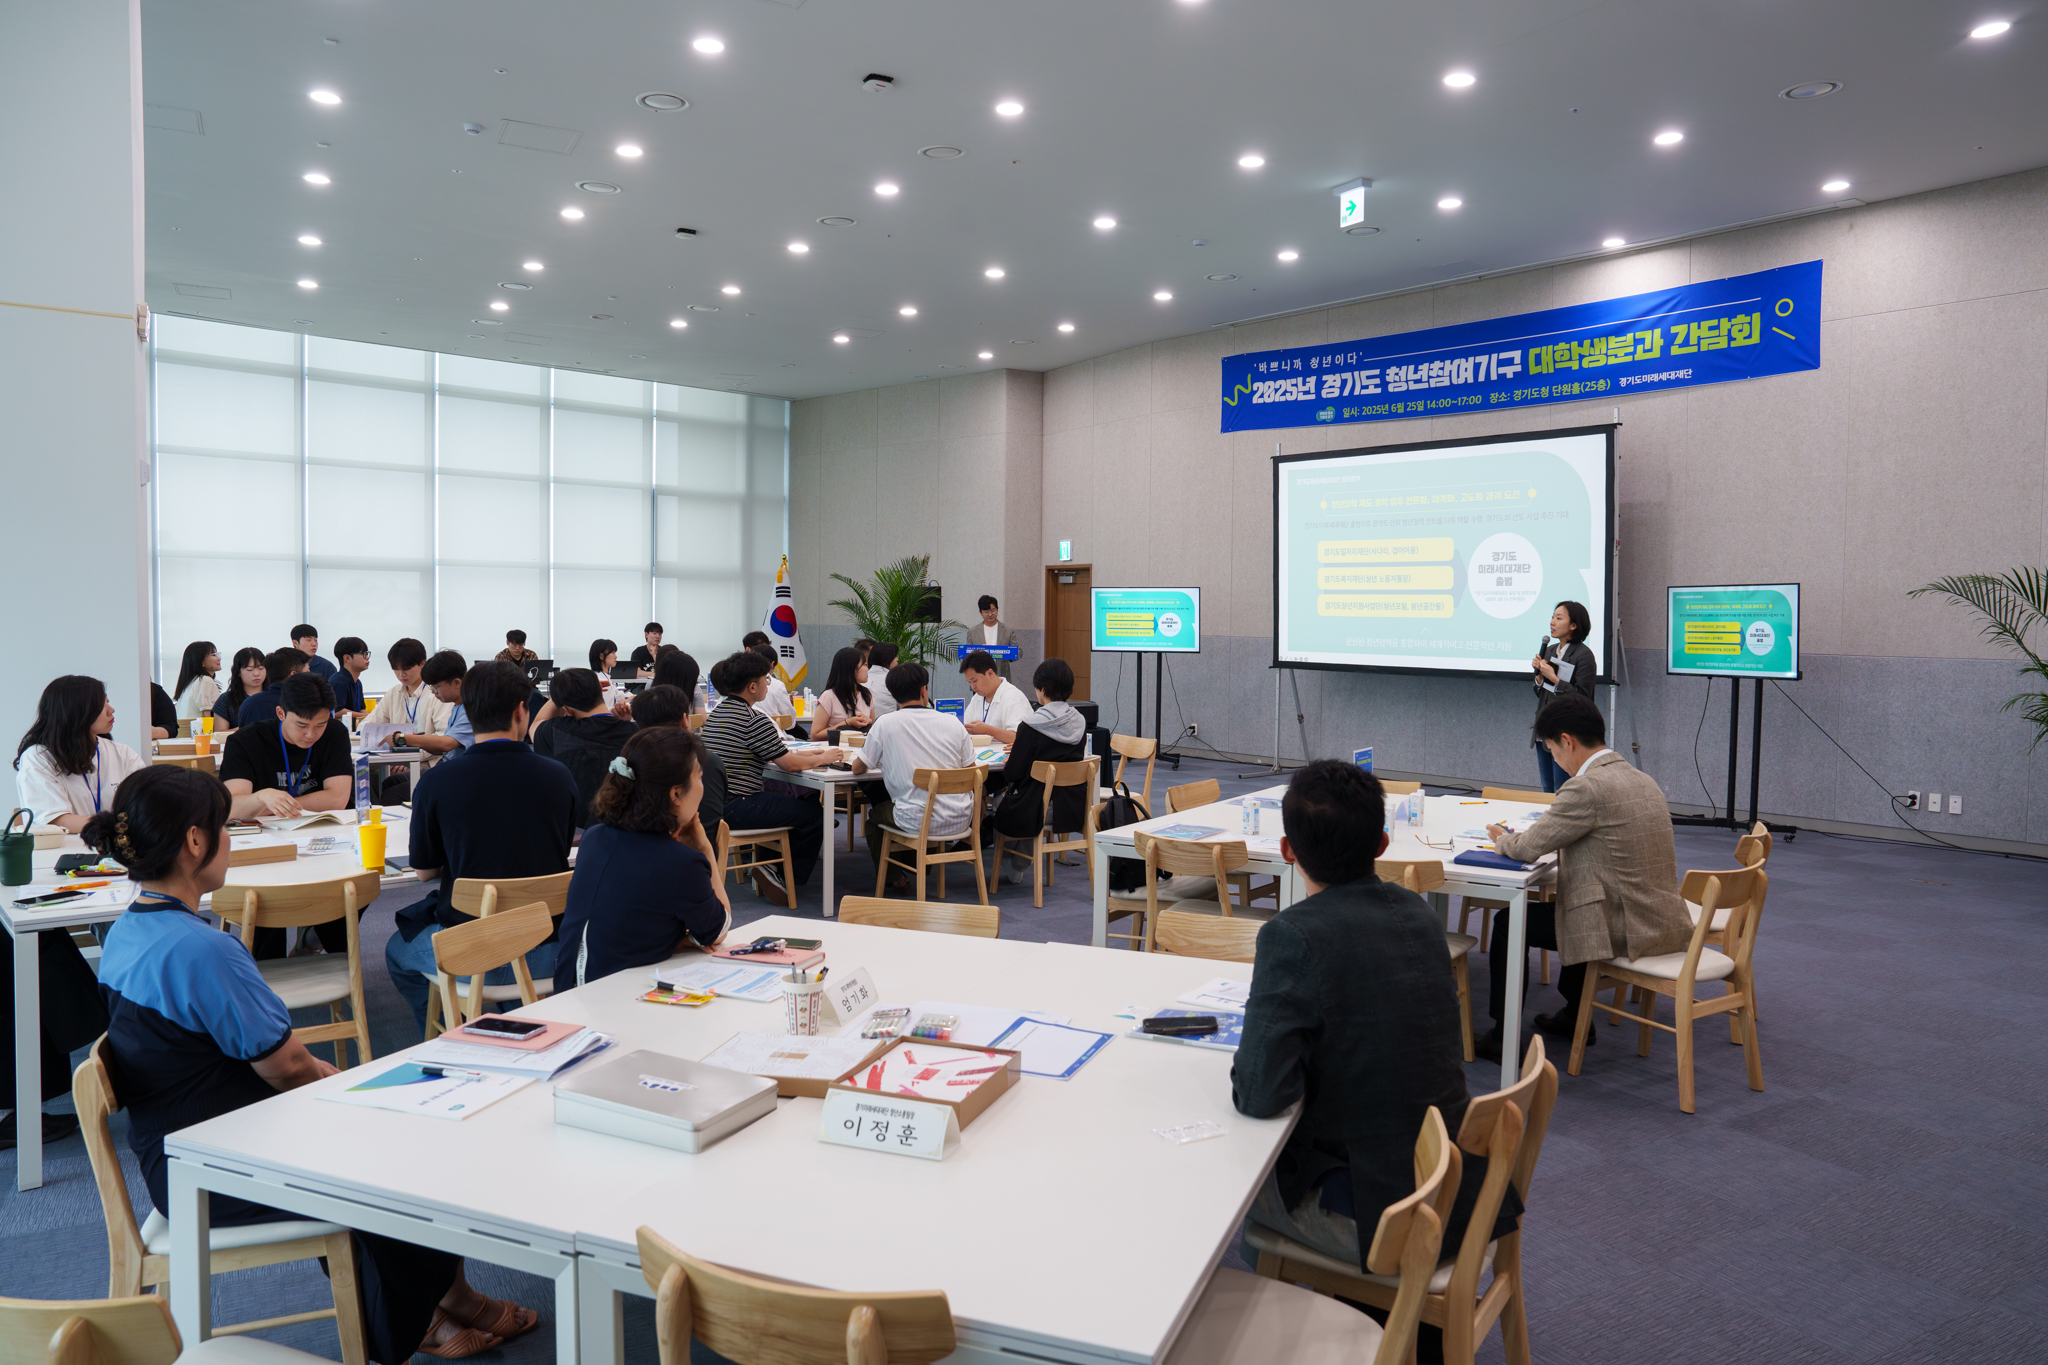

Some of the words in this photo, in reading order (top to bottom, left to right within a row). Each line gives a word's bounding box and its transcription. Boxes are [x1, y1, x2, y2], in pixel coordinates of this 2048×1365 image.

[1252, 376, 1316, 404] 2025년
[1321, 369, 1382, 398] 경기도
[1385, 350, 1522, 389] 청년참여기구
[1528, 329, 1664, 376] 대학생분과
[1670, 312, 1761, 356] 간담회
[1619, 368, 1693, 388] 경기도미래세대재단
[1343, 407, 1360, 418] 일시:
[1362, 404, 1389, 416] 2025년
[1391, 402, 1405, 413] 6월
[1406, 400, 1425, 413] 25일
[1426, 395, 1482, 409] 14:00~17:00
[1489, 391, 1511, 403] 장소:
[1513, 386, 1550, 401] 경기도청
[1552, 379, 1611, 396] 단원홀(25층)
[1390, 495, 1404, 506] 이후
[1460, 491, 1484, 502] 고도화
[1526, 510, 1540, 521] 사업
[1555, 509, 1570, 519] 기대
[1491, 551, 1517, 562] 경기도
[1478, 563, 1532, 575] 미래세대재단
[1495, 576, 1513, 587] 출범
[1465, 640, 1496, 651] 전문적인
[1496, 640, 1513, 652] 지원
[842, 985, 869, 1013] 엄기화
[843, 1116, 919, 1147] 이정훈
